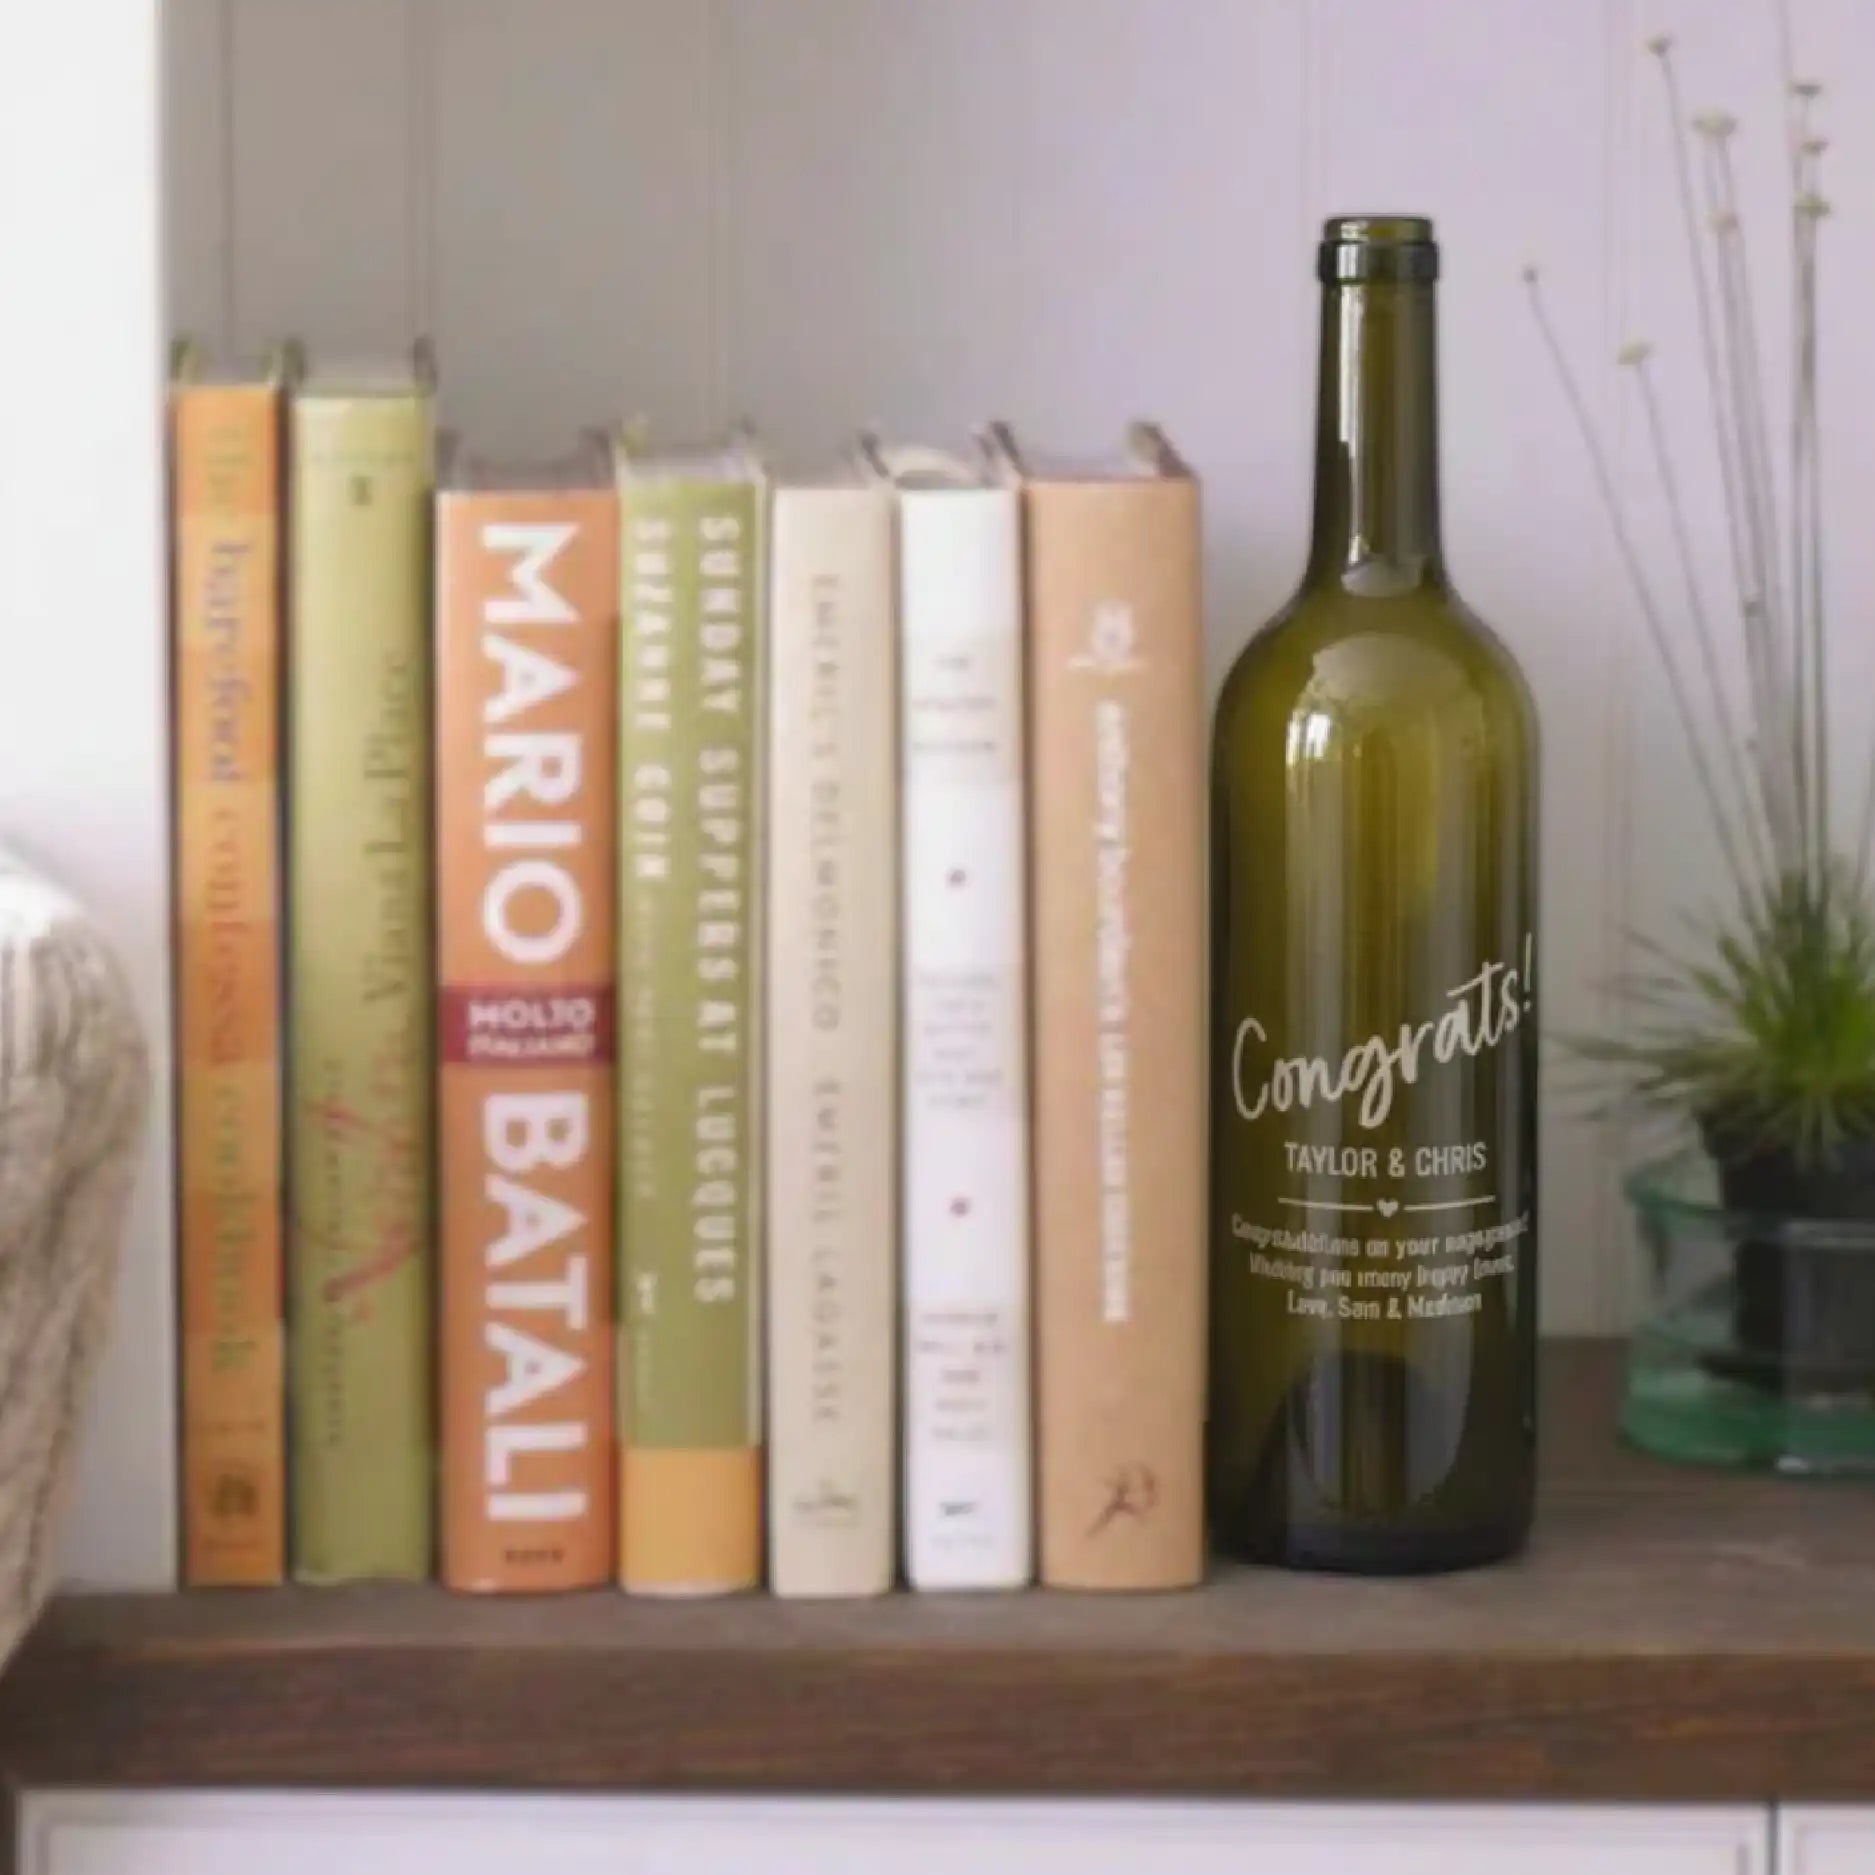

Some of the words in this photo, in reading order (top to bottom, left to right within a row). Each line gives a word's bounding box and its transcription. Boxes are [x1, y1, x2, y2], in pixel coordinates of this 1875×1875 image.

[699, 517, 742, 714] SUNDAY
[480, 520, 584, 966] MARIO
[699, 748, 742, 981] SUPPERS
[468, 998, 597, 1029] MOLTO
[699, 1001, 738, 1053] AT
[1233, 932, 1533, 1129] Congrats!
[691, 1087, 738, 1303] LUCQUES
[1284, 1141, 1377, 1178] TAYLOR
[1388, 1147, 1405, 1177] &
[1415, 1141, 1488, 1177] CHRIS
[482, 1092, 590, 1521] BATALI
[1338, 1295, 1380, 1320] Sam
[1357, 1268, 1412, 1293] many
[1366, 1237, 1391, 1257] on
[1396, 1235, 1440, 1260] your
